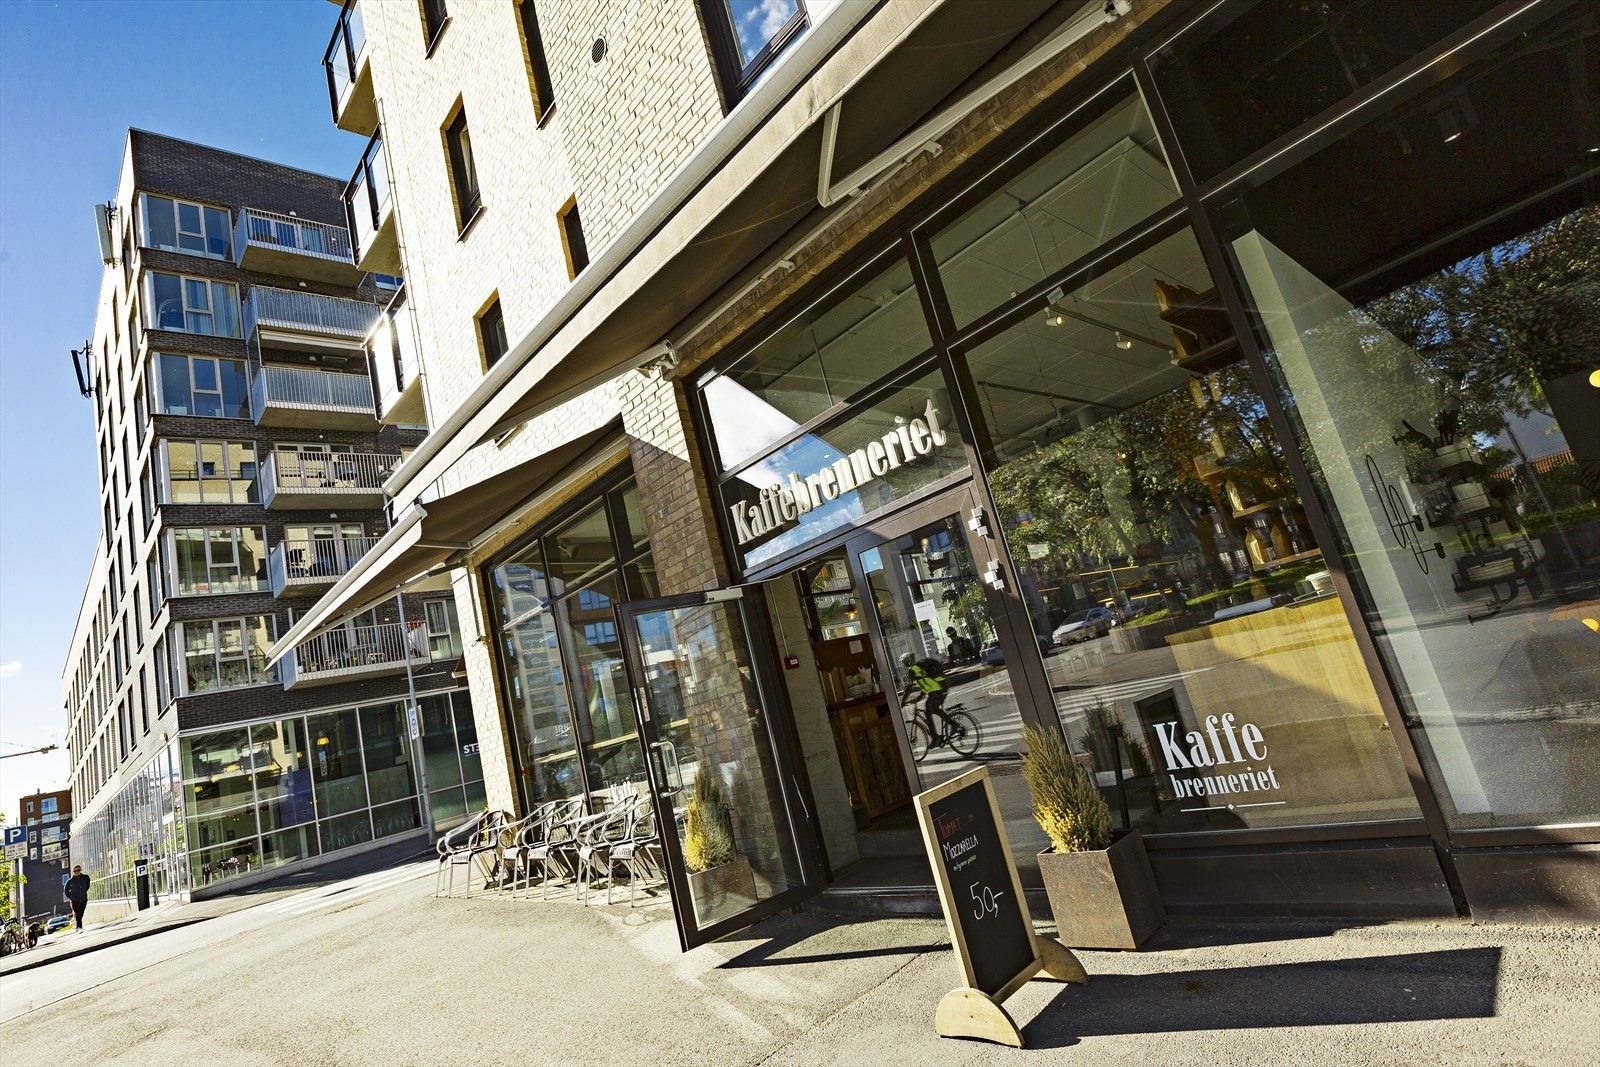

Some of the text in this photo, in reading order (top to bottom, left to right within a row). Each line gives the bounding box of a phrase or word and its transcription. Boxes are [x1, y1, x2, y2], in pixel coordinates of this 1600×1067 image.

[730, 399, 947, 546] Kaffebrenneriet
[1152, 712, 1268, 771] Kaffe
[1169, 764, 1281, 799] brenneriet
[10, 828, 22, 843] P
[139, 866, 146, 875] P
